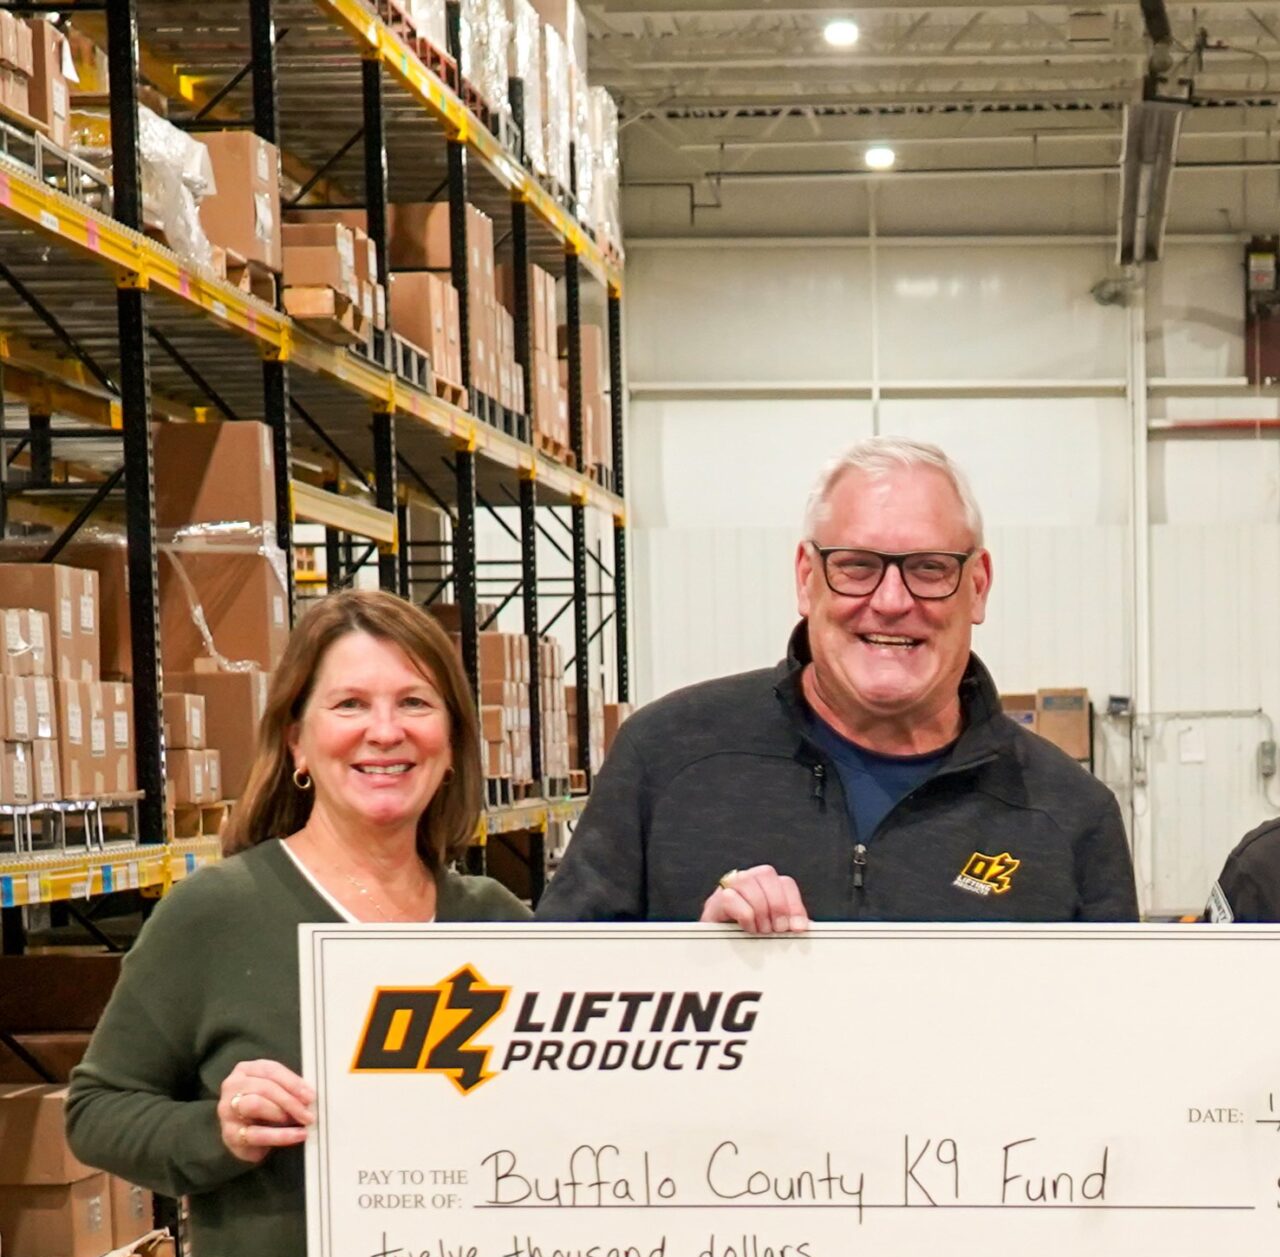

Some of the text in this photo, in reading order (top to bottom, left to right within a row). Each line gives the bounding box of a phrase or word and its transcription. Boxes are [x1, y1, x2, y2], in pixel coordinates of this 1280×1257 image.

[513, 990, 763, 1034] LIFTING
[501, 1039, 748, 1072] PRODUCTS
[1187, 1107, 1244, 1124] DATE:
[358, 1169, 468, 1186] PAY TO THE
[481, 1135, 1109, 1224] Buffalo County K9 Fund
[358, 1193, 462, 1209] ORDER OF:
